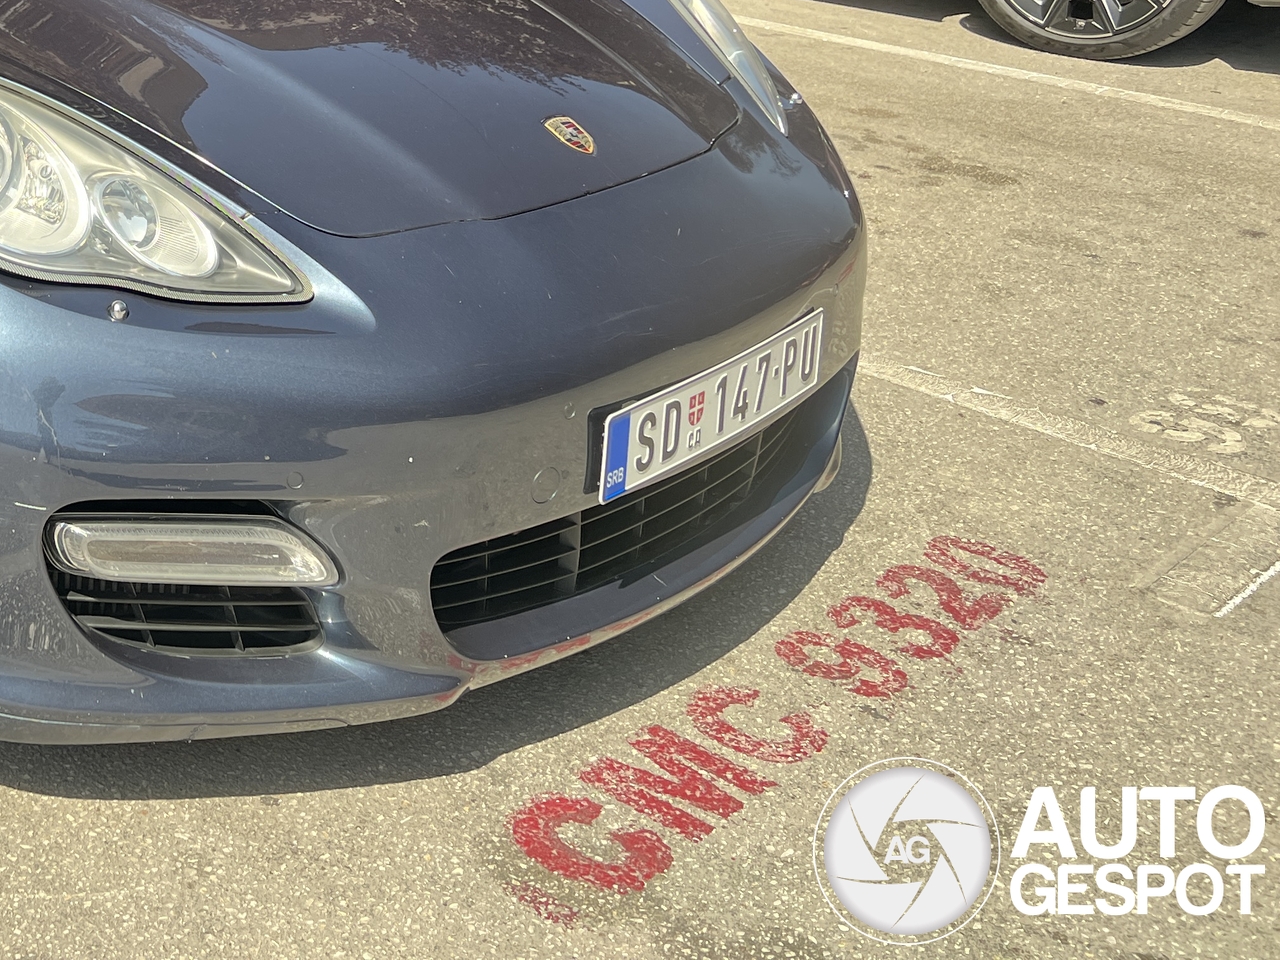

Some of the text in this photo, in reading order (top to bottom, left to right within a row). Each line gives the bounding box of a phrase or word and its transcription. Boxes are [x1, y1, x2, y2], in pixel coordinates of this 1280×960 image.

[634, 323, 818, 474] SD 147-PU
[606, 466, 625, 489] SRB
[774, 535, 1048, 697] 9320
